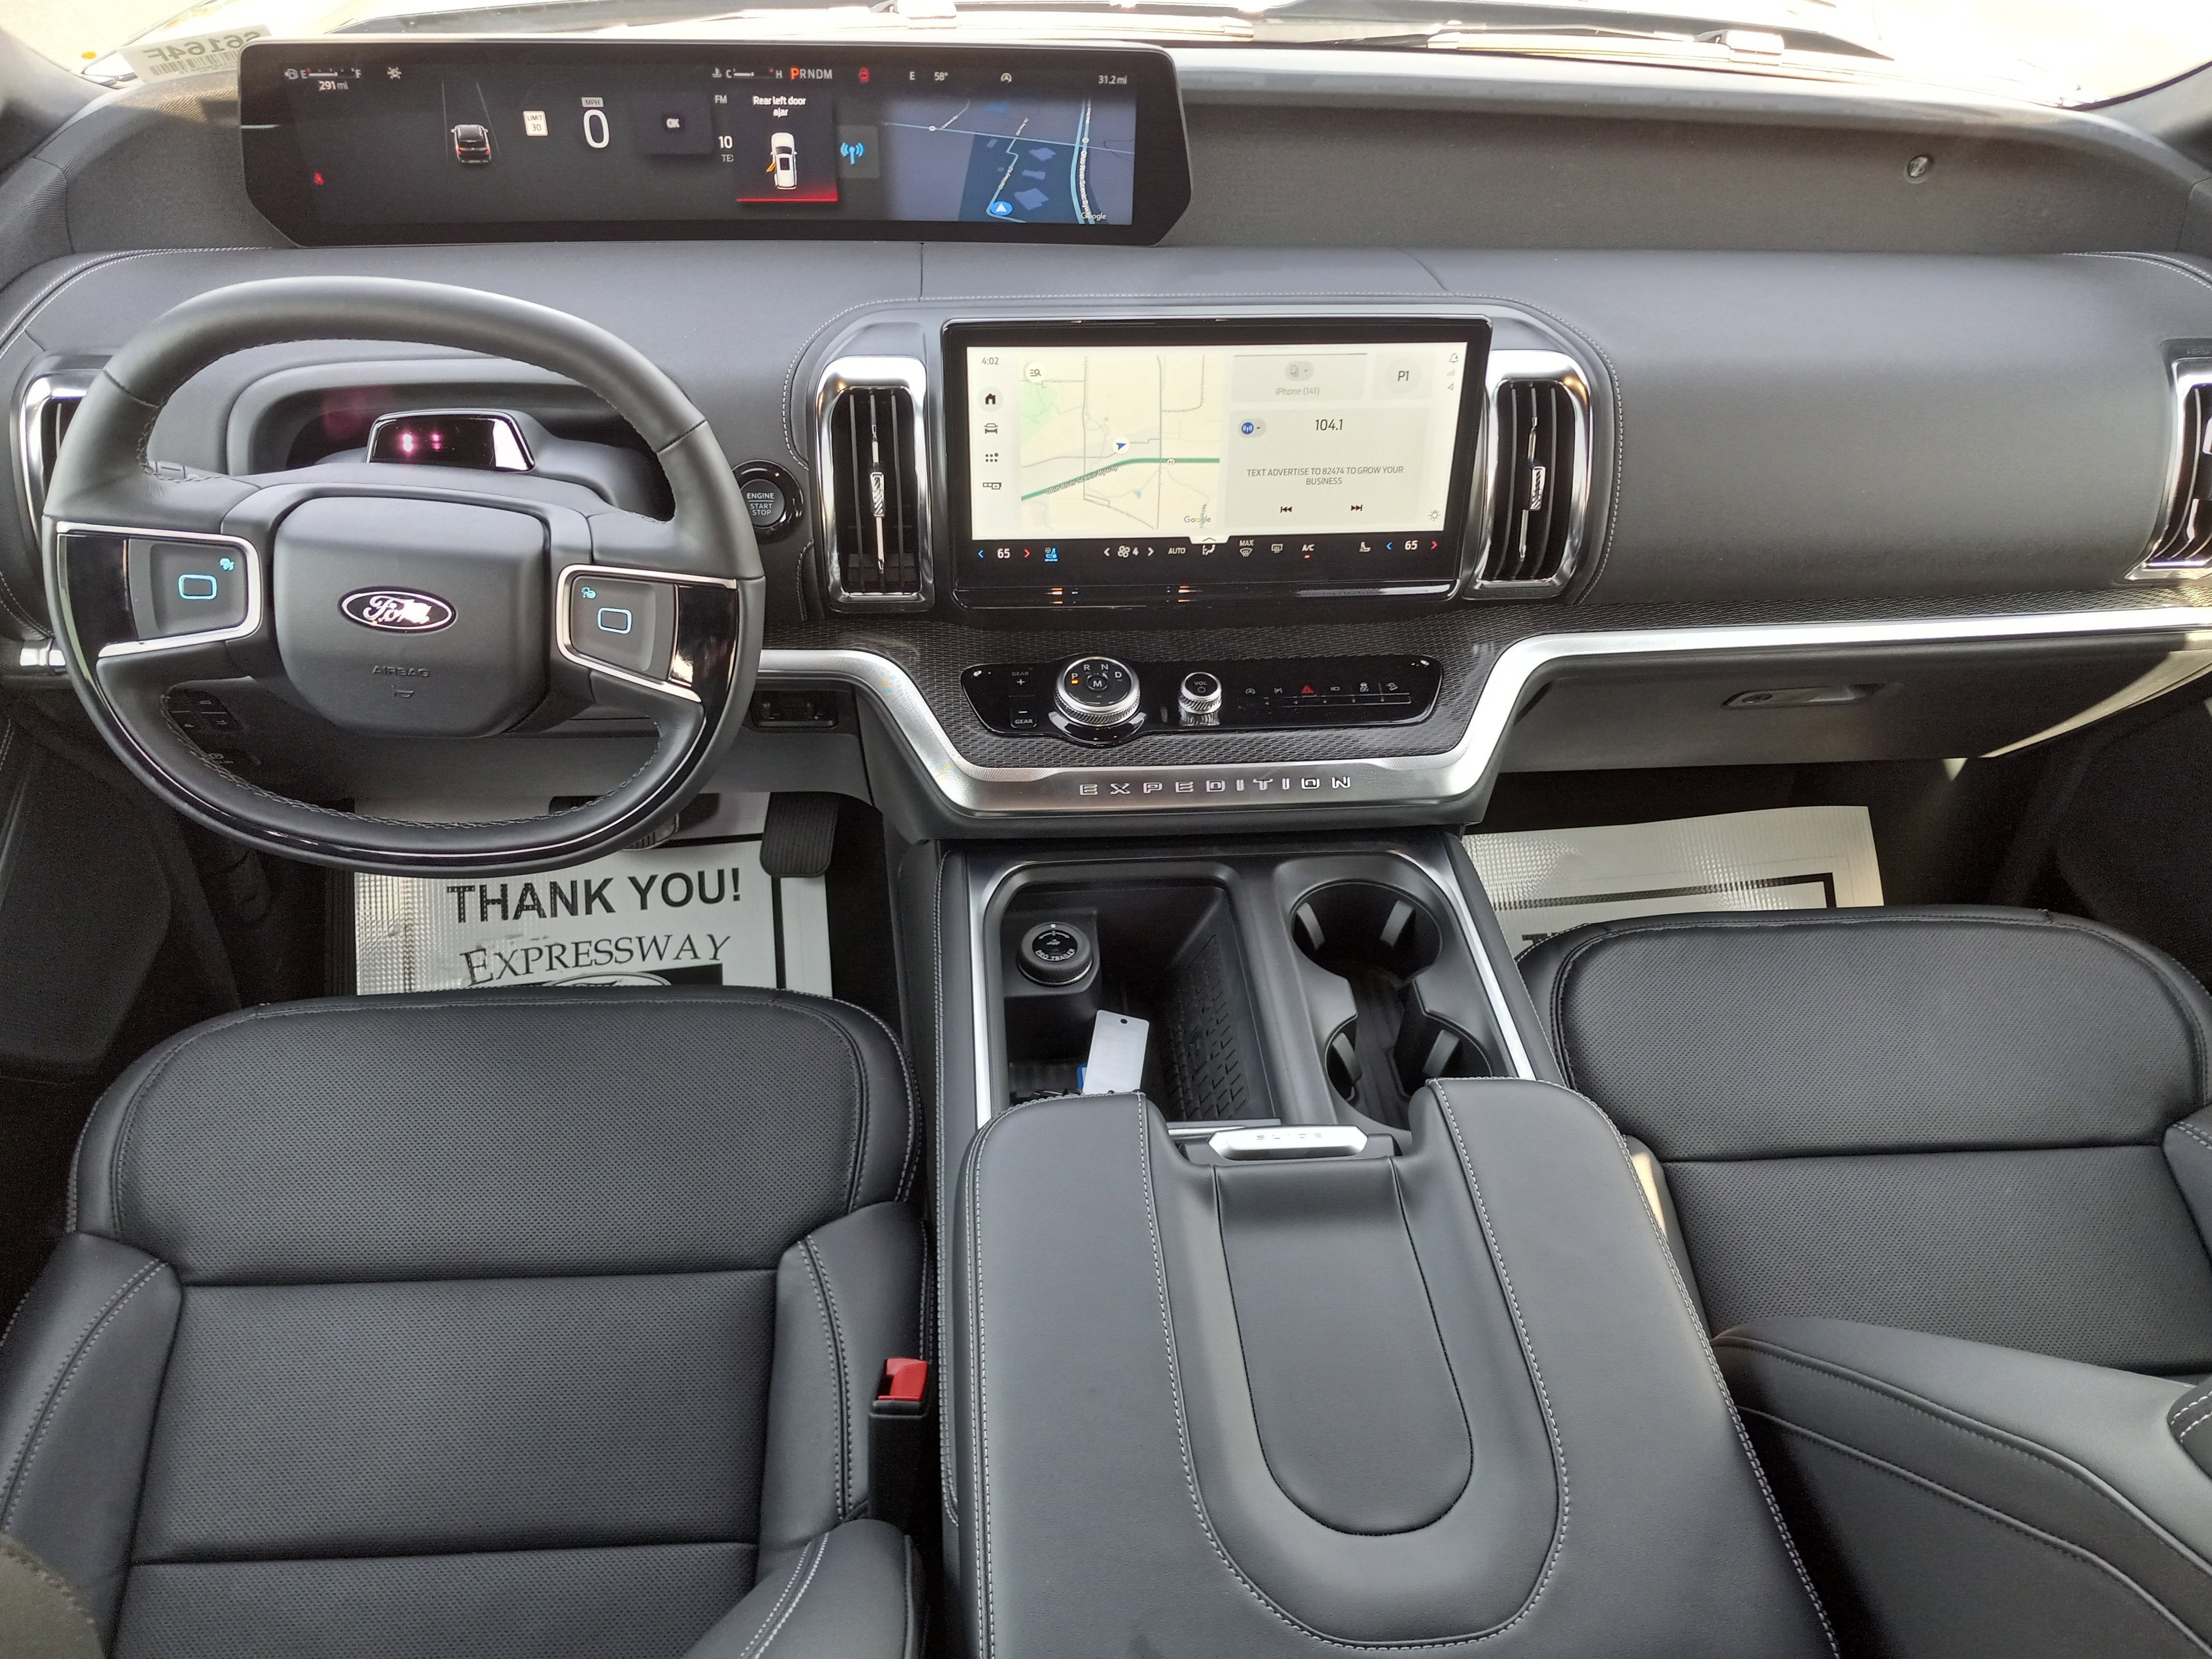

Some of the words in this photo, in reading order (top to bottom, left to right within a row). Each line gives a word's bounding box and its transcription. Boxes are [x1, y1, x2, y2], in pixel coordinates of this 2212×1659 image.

[726, 70, 733, 78] C
[776, 70, 782, 79] H
[909, 72, 915, 80] E
[1098, 75, 1117, 84] 31.2
[1118, 76, 1127, 84] mi
[319, 81, 336, 90] 291
[714, 95, 727, 104] FM
[753, 96, 772, 106] Rear
[772, 96, 787, 105] left
[788, 96, 806, 105] door
[773, 108, 789, 118] ajar
[583, 109, 610, 148] 0
[982, 357, 999, 366] 4:02
[1397, 371, 1409, 382] P1
[1275, 387, 1301, 396] iPhone
[1303, 387, 1320, 396] (141)
[1315, 419, 1343, 431] 104.1
[1045, 485, 1060, 495] Ohio
[1060, 480, 1077, 490] River
[1076, 472, 1098, 483] Scenic
[1097, 464, 1118, 476] Byway
[1306, 477, 1342, 485] BUSINESS
[1184, 516, 1211, 525] Google
[1405, 541, 1418, 550] 65
[997, 549, 1010, 558] 65
[1080, 777, 1350, 795] EXPEDITION
[446, 877, 617, 923] THANK
[628, 867, 741, 911] YOU!
[1035, 950, 1049, 960] PRO
[1050, 948, 1075, 961] TRAILER
